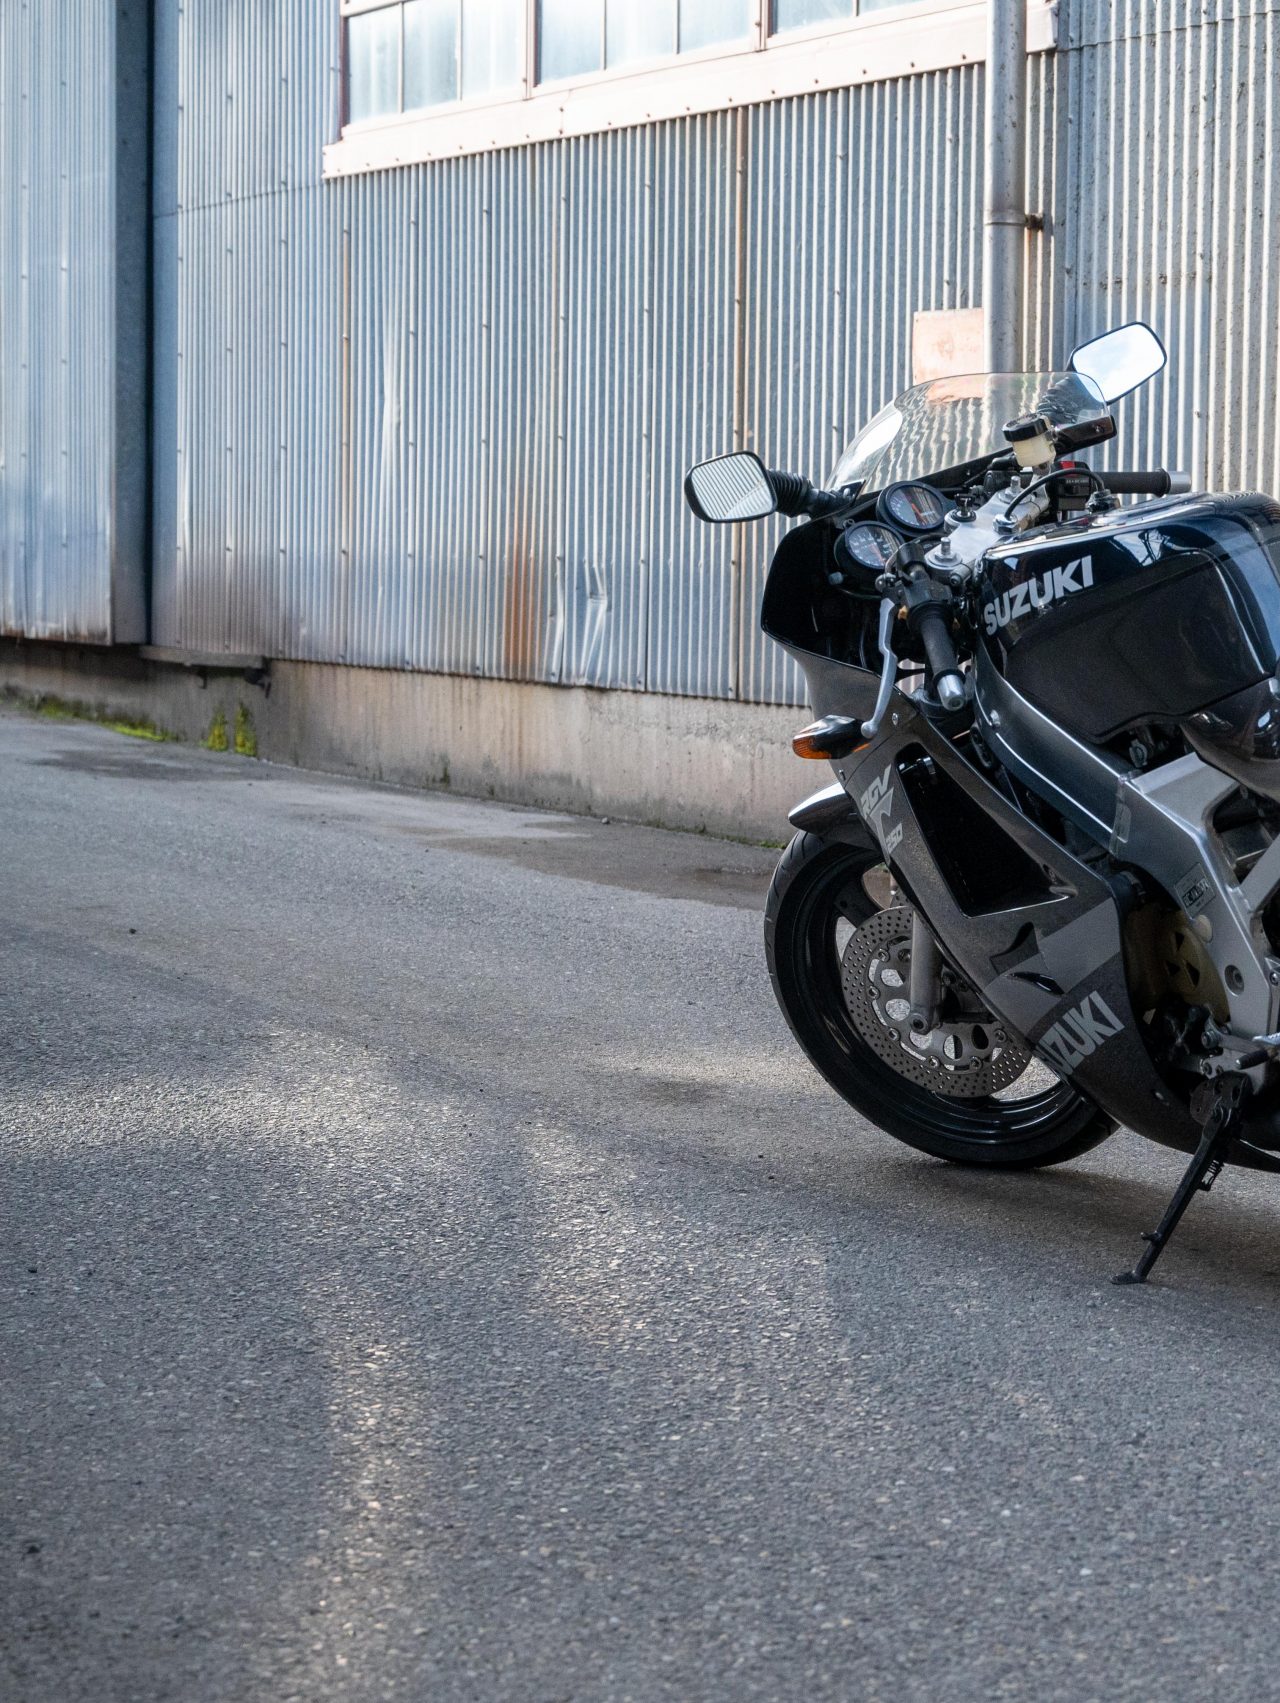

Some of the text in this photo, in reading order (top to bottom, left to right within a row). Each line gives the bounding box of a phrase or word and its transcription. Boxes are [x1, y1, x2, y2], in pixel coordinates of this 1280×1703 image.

[984, 555, 1094, 636] SUZUKI
[861, 763, 892, 820] RGV
[1035, 990, 1125, 1076] UZUKI
